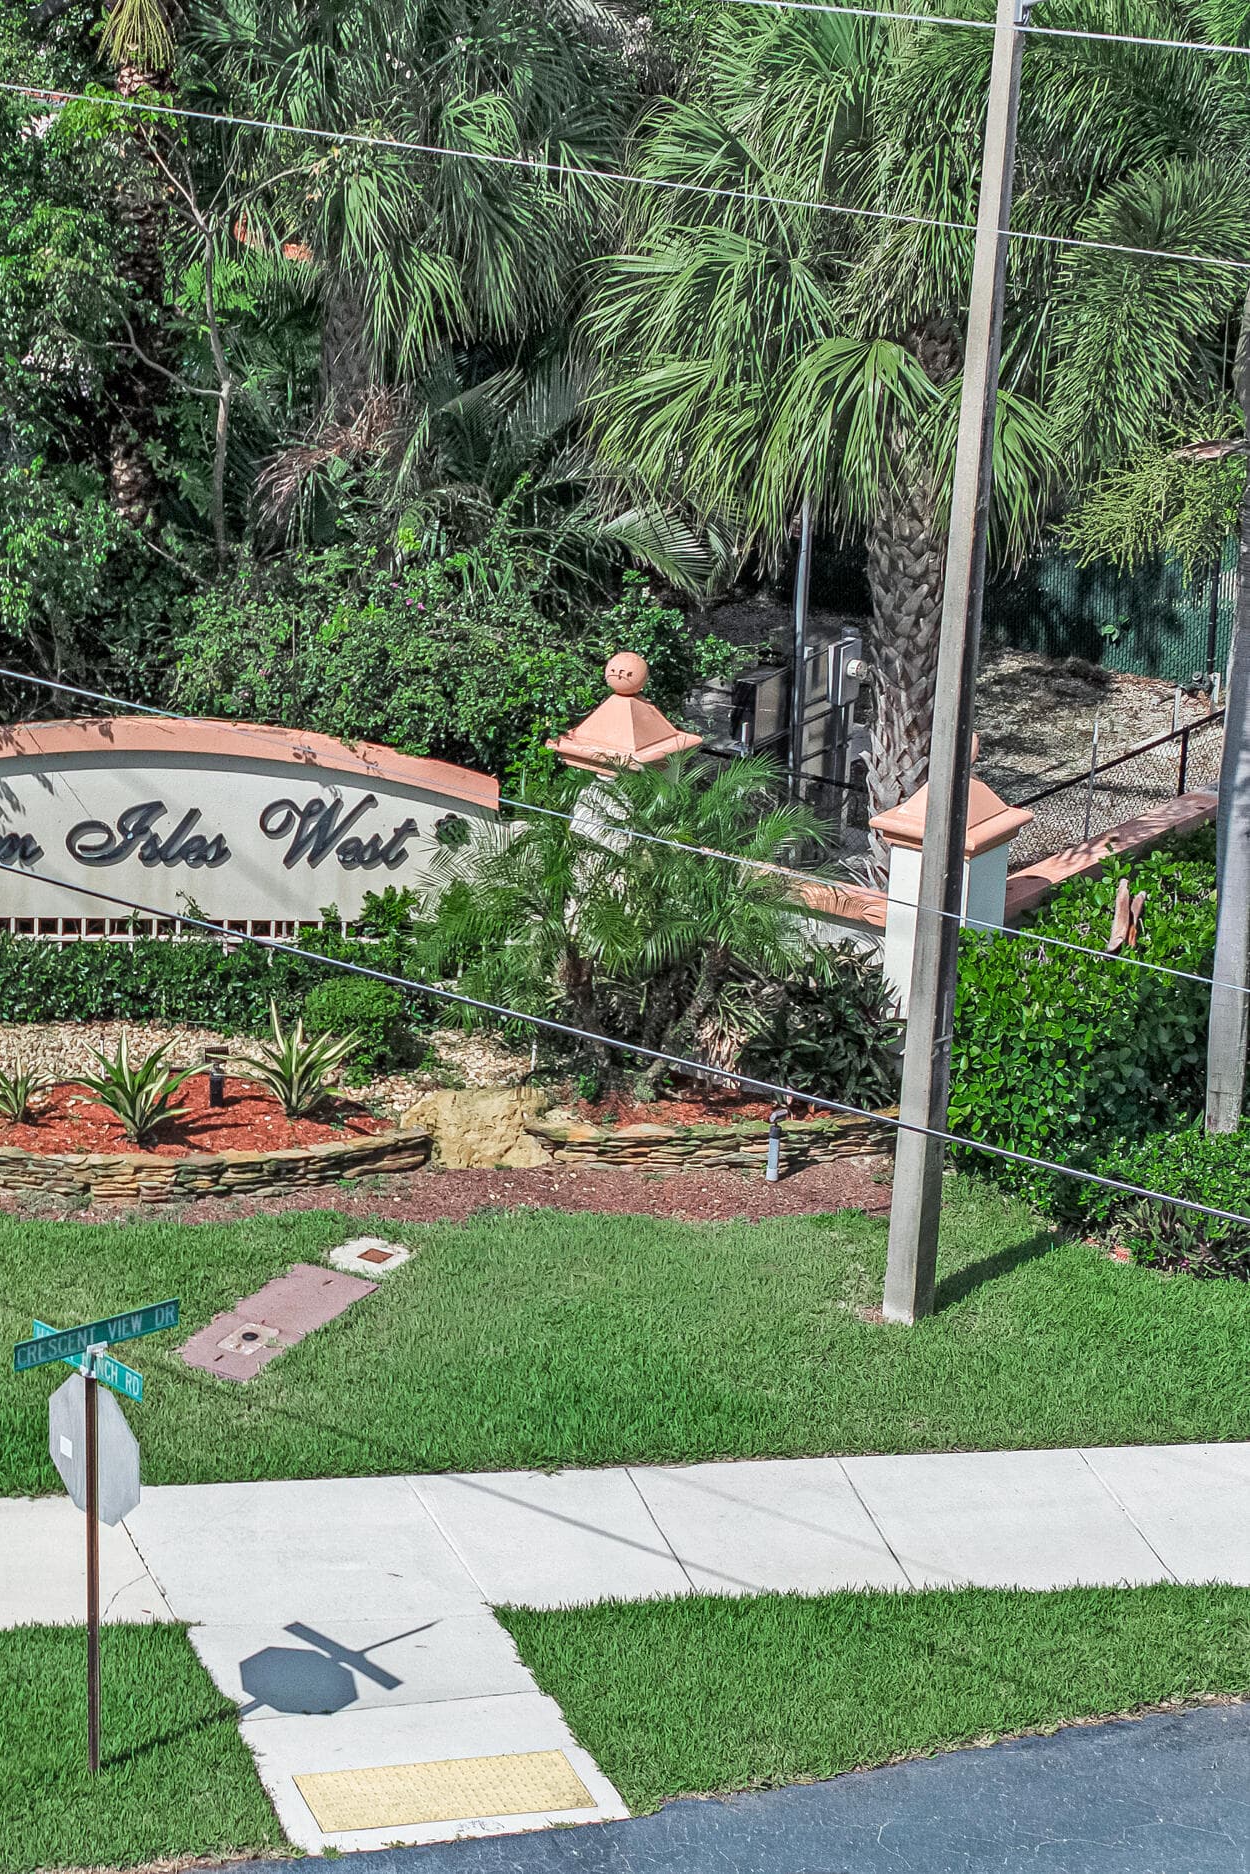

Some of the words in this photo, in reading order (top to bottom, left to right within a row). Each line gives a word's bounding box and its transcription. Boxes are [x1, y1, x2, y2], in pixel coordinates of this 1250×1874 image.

[66, 800, 232, 868] Isles
[259, 793, 420, 870] West
[17, 1326, 96, 1365] CRESCENT
[108, 1313, 142, 1340] VIEW
[155, 1305, 175, 1327] DR
[125, 1371, 139, 1396] RD
